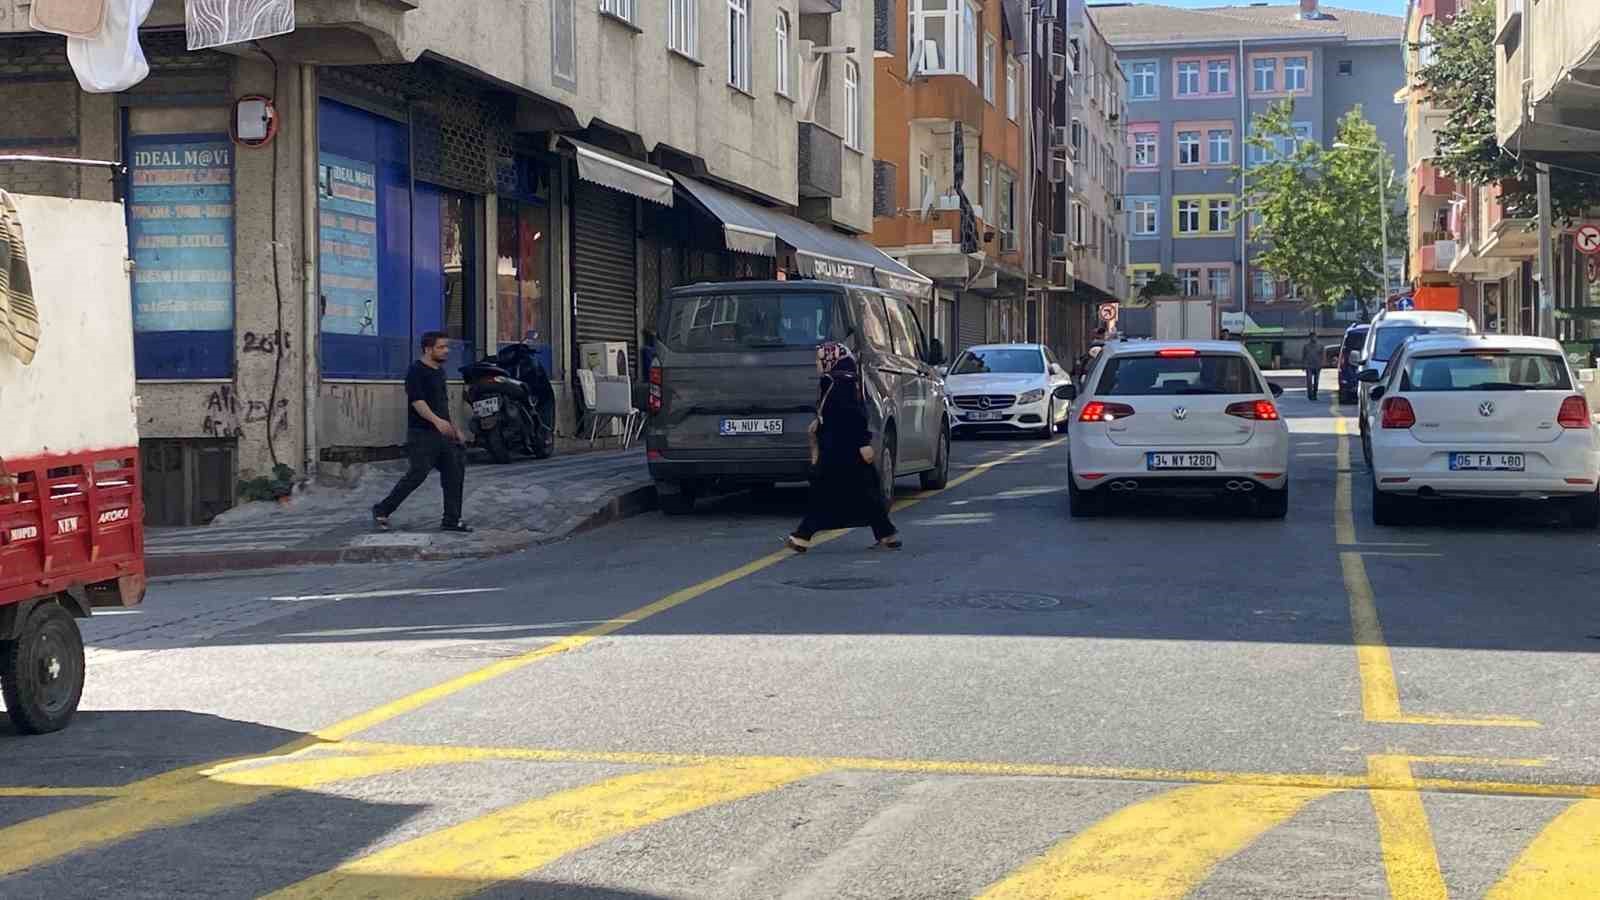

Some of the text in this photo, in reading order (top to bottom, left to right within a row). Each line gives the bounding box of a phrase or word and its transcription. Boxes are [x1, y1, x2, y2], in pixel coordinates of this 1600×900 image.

[135, 149, 228, 166] iDEAL M@Vi
[725, 420, 781, 431] 34 NUY 465
[1155, 455, 1212, 466] 34 NY 1280
[1479, 455, 1492, 466] FA
[57, 517, 79, 534] NEW
